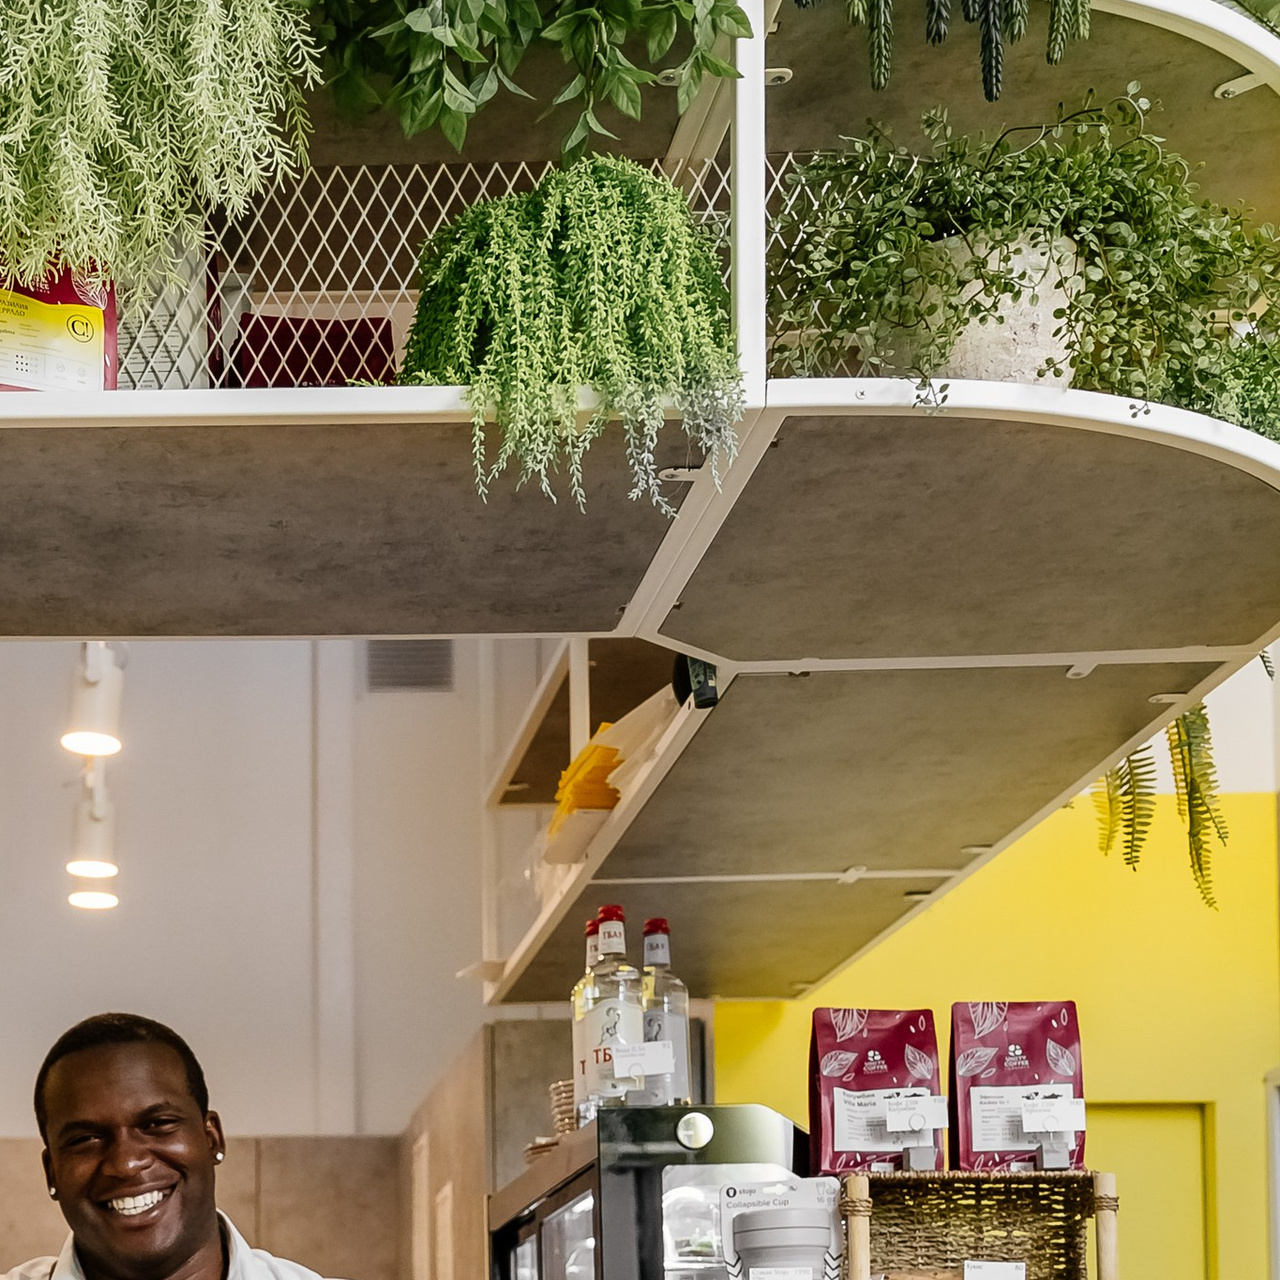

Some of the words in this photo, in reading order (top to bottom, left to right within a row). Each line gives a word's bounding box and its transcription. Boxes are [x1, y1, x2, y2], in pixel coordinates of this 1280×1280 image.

[593, 1047, 612, 1065] ТБ
[738, 1188, 756, 1197] stojo
[726, 1198, 770, 1209] Collapsible
[772, 1198, 790, 1208] Cup
